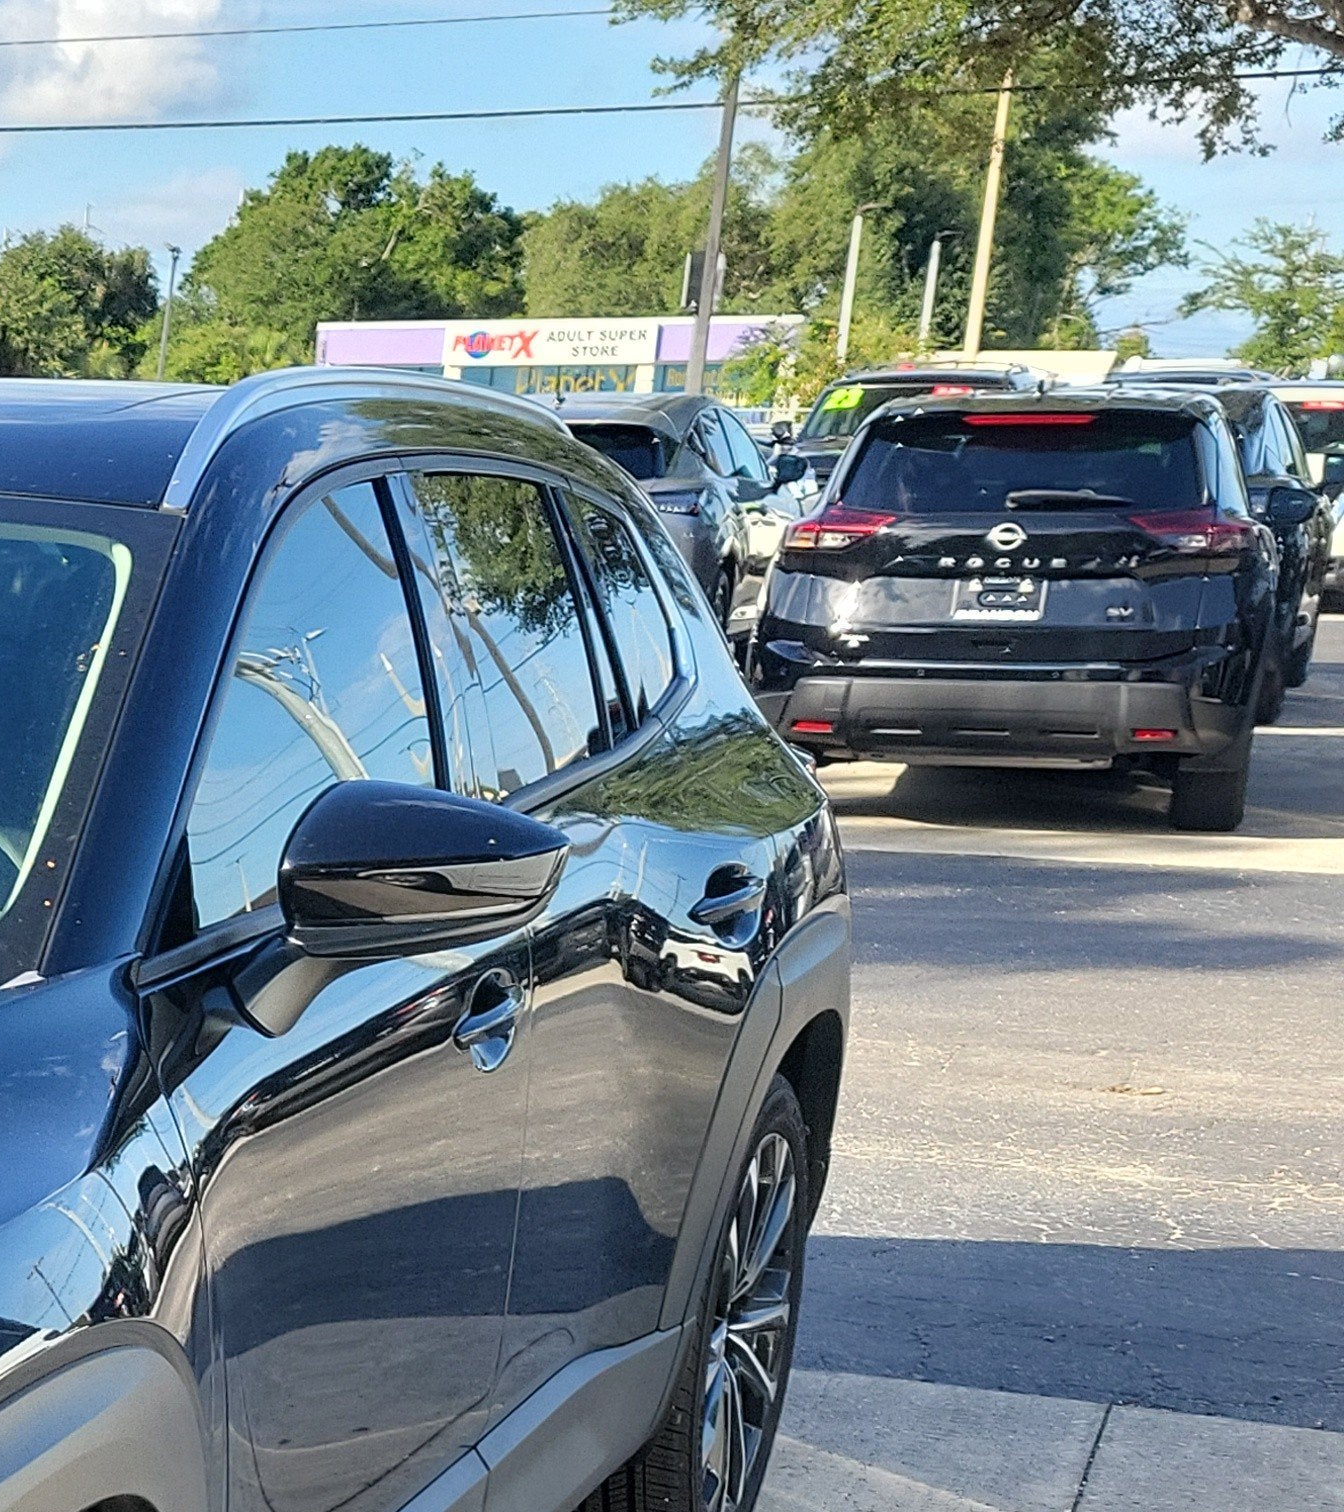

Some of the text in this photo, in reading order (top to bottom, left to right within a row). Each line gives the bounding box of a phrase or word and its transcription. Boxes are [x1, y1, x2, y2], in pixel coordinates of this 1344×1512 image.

[546, 329, 647, 342] ADULT SUPER
[571, 345, 619, 357] STORE
[938, 556, 1068, 569] ROGUE
[1106, 607, 1134, 617] SV
